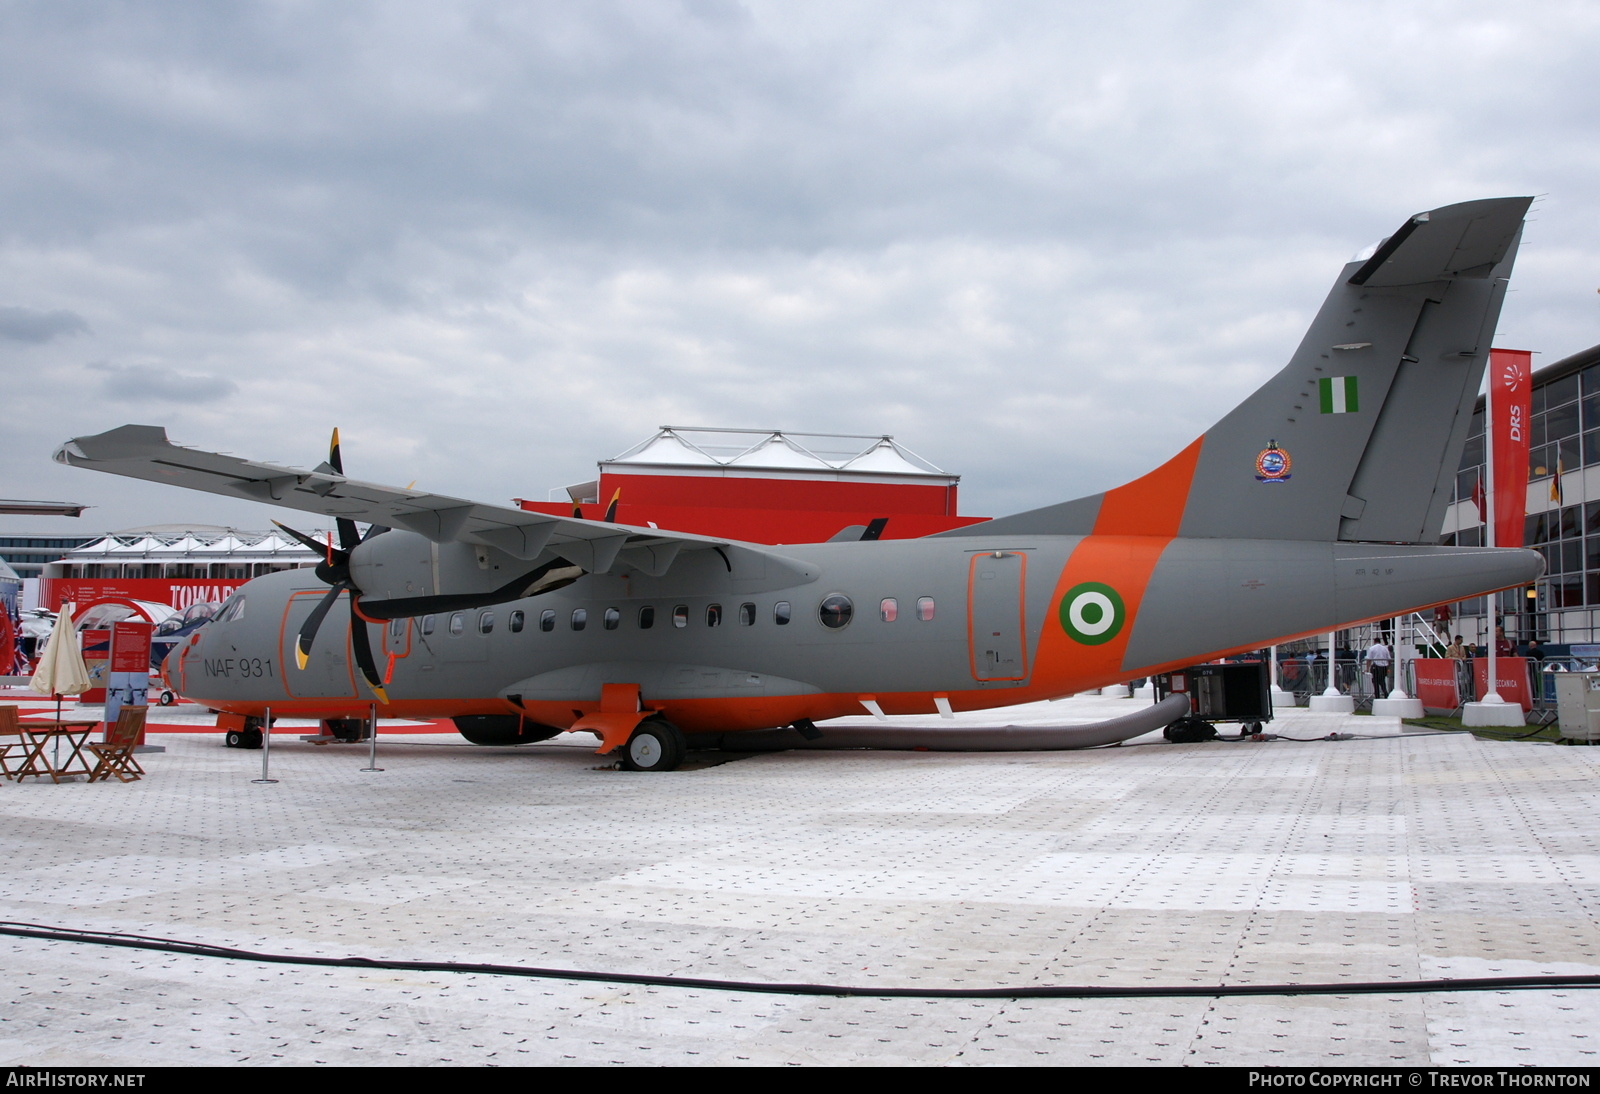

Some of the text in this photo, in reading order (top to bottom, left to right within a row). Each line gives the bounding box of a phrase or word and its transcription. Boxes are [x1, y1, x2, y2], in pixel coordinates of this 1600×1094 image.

[1510, 404, 1521, 442] DRS
[204, 658, 273, 678] NAF 931
